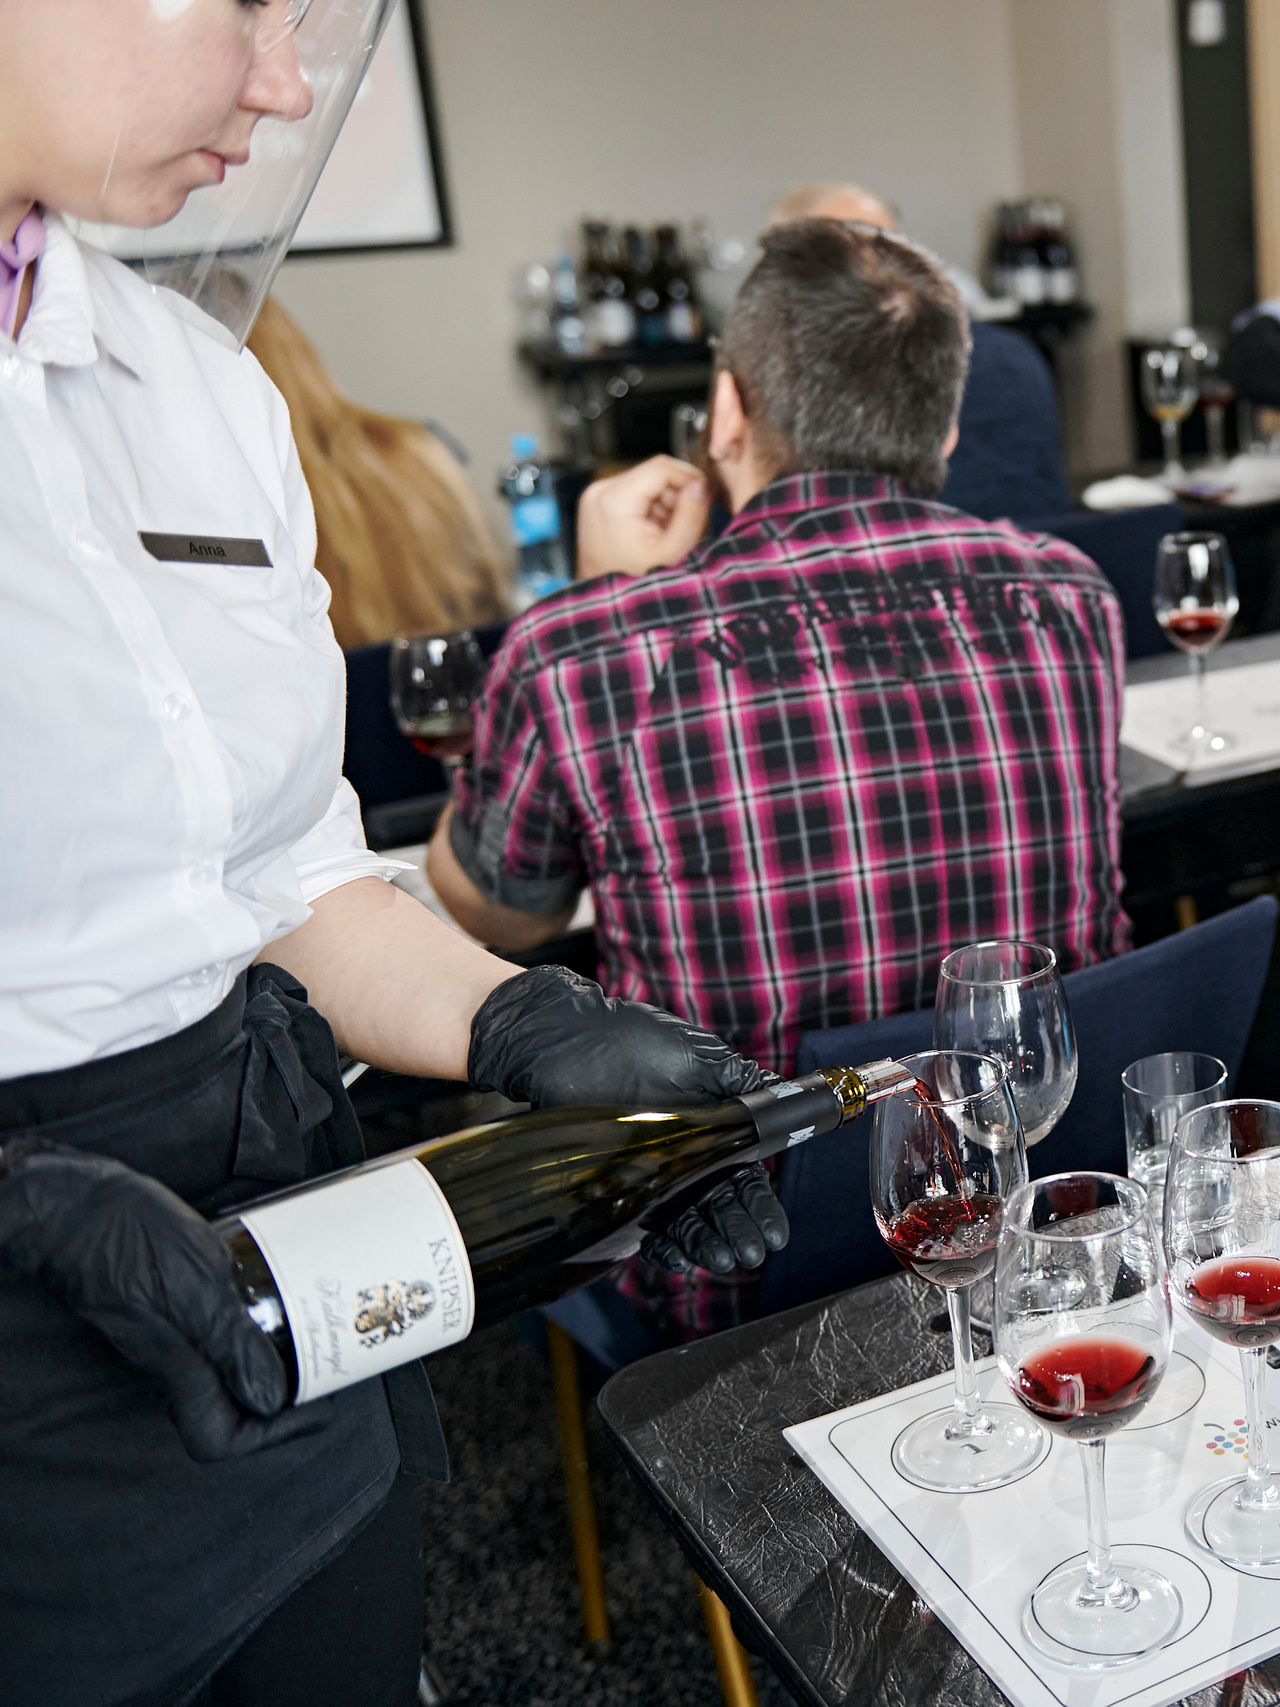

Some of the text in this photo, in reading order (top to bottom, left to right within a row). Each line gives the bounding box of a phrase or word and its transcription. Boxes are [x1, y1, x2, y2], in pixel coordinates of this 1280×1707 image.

[189, 542, 226, 557] Anna
[428, 1237, 462, 1334] KNIPSER
[960, 1443, 988, 1455] 1
